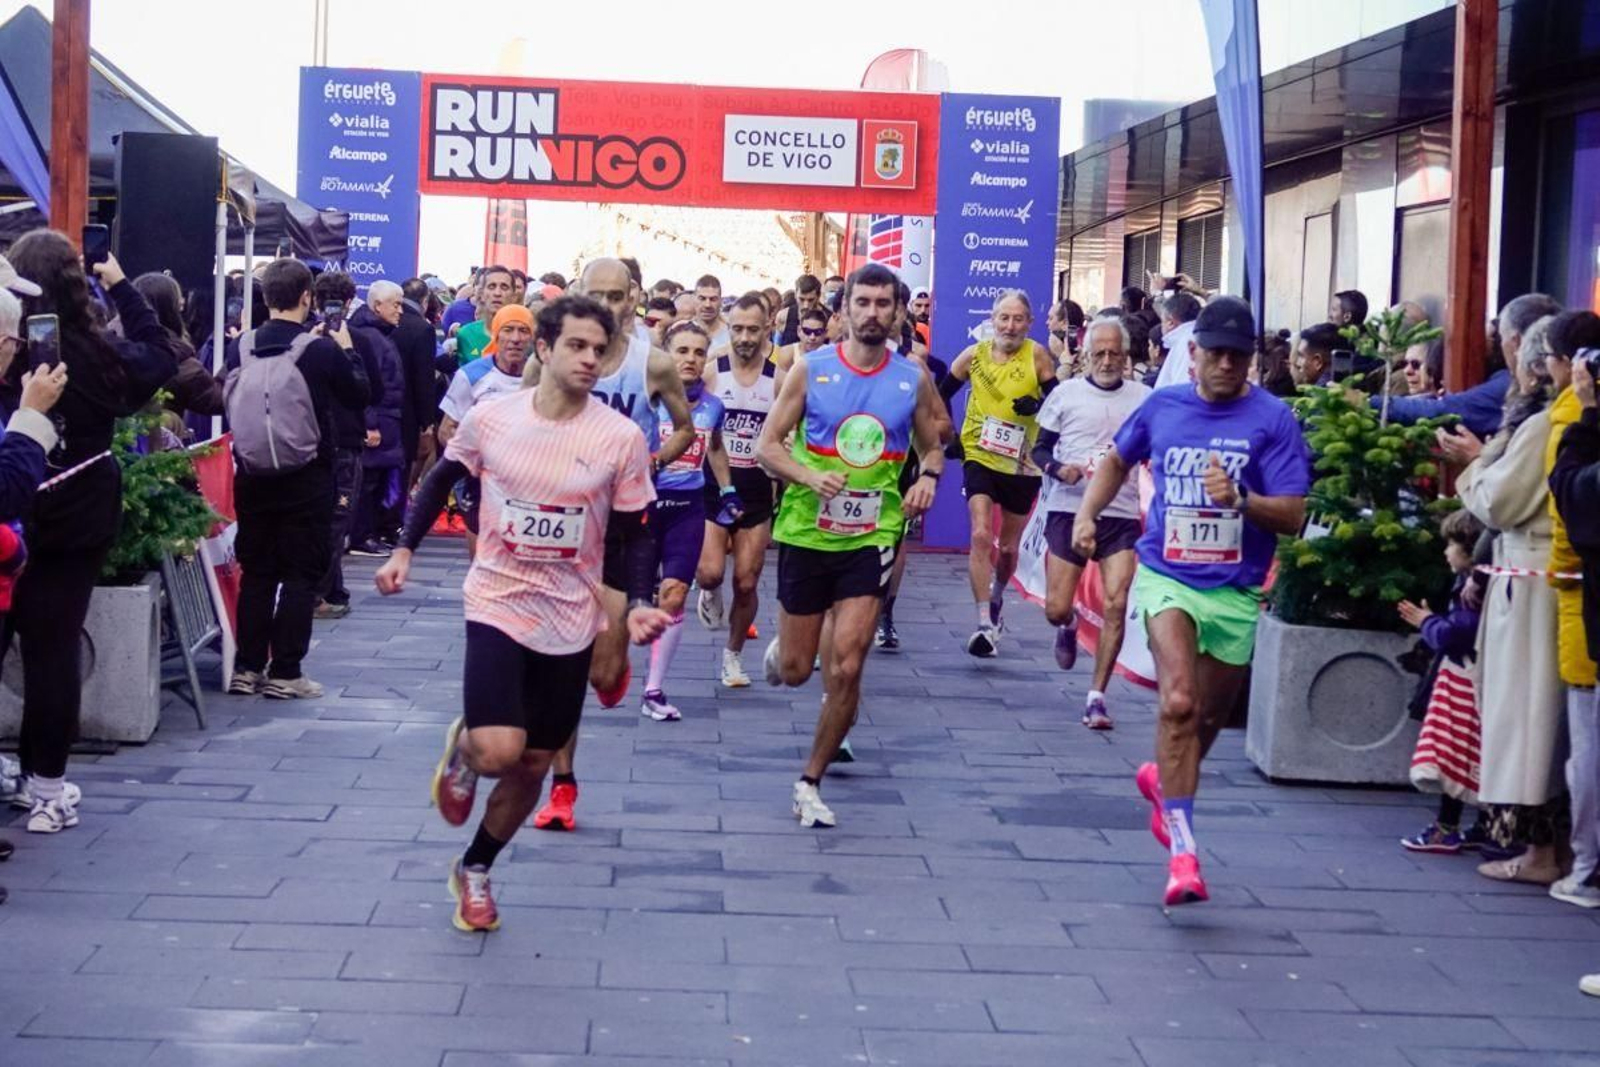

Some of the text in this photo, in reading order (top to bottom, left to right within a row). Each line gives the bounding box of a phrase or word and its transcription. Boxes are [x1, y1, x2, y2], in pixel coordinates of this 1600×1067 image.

[436, 87, 556, 134] RUN
[345, 114, 390, 129] vialia
[735, 129, 846, 150] CONCELLO
[986, 140, 1031, 155] vialia
[329, 145, 388, 163] Alcampo
[747, 151, 833, 170] DE VIGO
[970, 172, 1028, 188] Alcampo
[980, 237, 1029, 247] COTERENA
[995, 427, 1011, 442] 55
[729, 440, 753, 454] 186
[843, 501, 862, 518] 96
[521, 516, 565, 540] 206
[1190, 523, 1220, 541] 171
